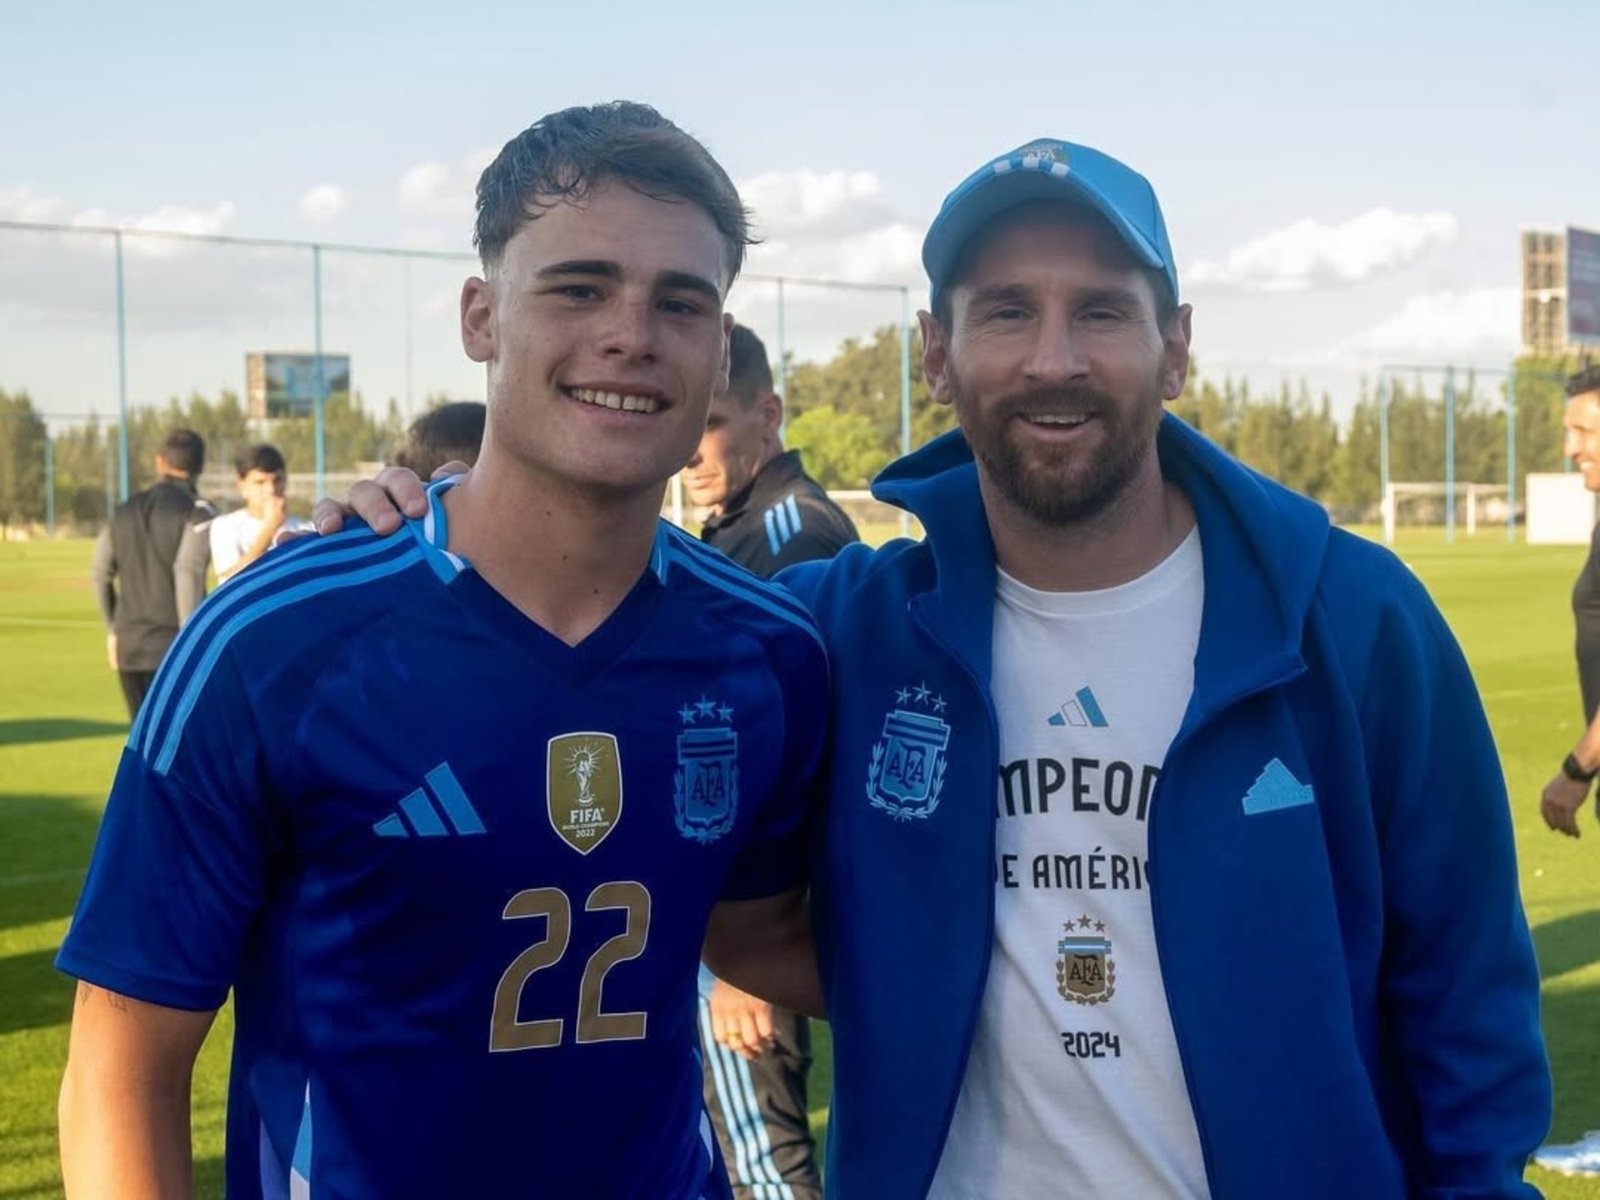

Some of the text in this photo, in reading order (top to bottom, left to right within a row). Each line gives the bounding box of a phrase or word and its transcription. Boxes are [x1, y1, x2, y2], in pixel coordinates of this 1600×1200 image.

[690, 760, 726, 807] AFA
[887, 741, 927, 789] AFA
[576, 829, 595, 838] 2022
[996, 846, 1150, 889] E AMÉRI
[489, 880, 652, 1052] 22
[1069, 954, 1104, 986] AFA
[1061, 1031, 1121, 1058] 2024
